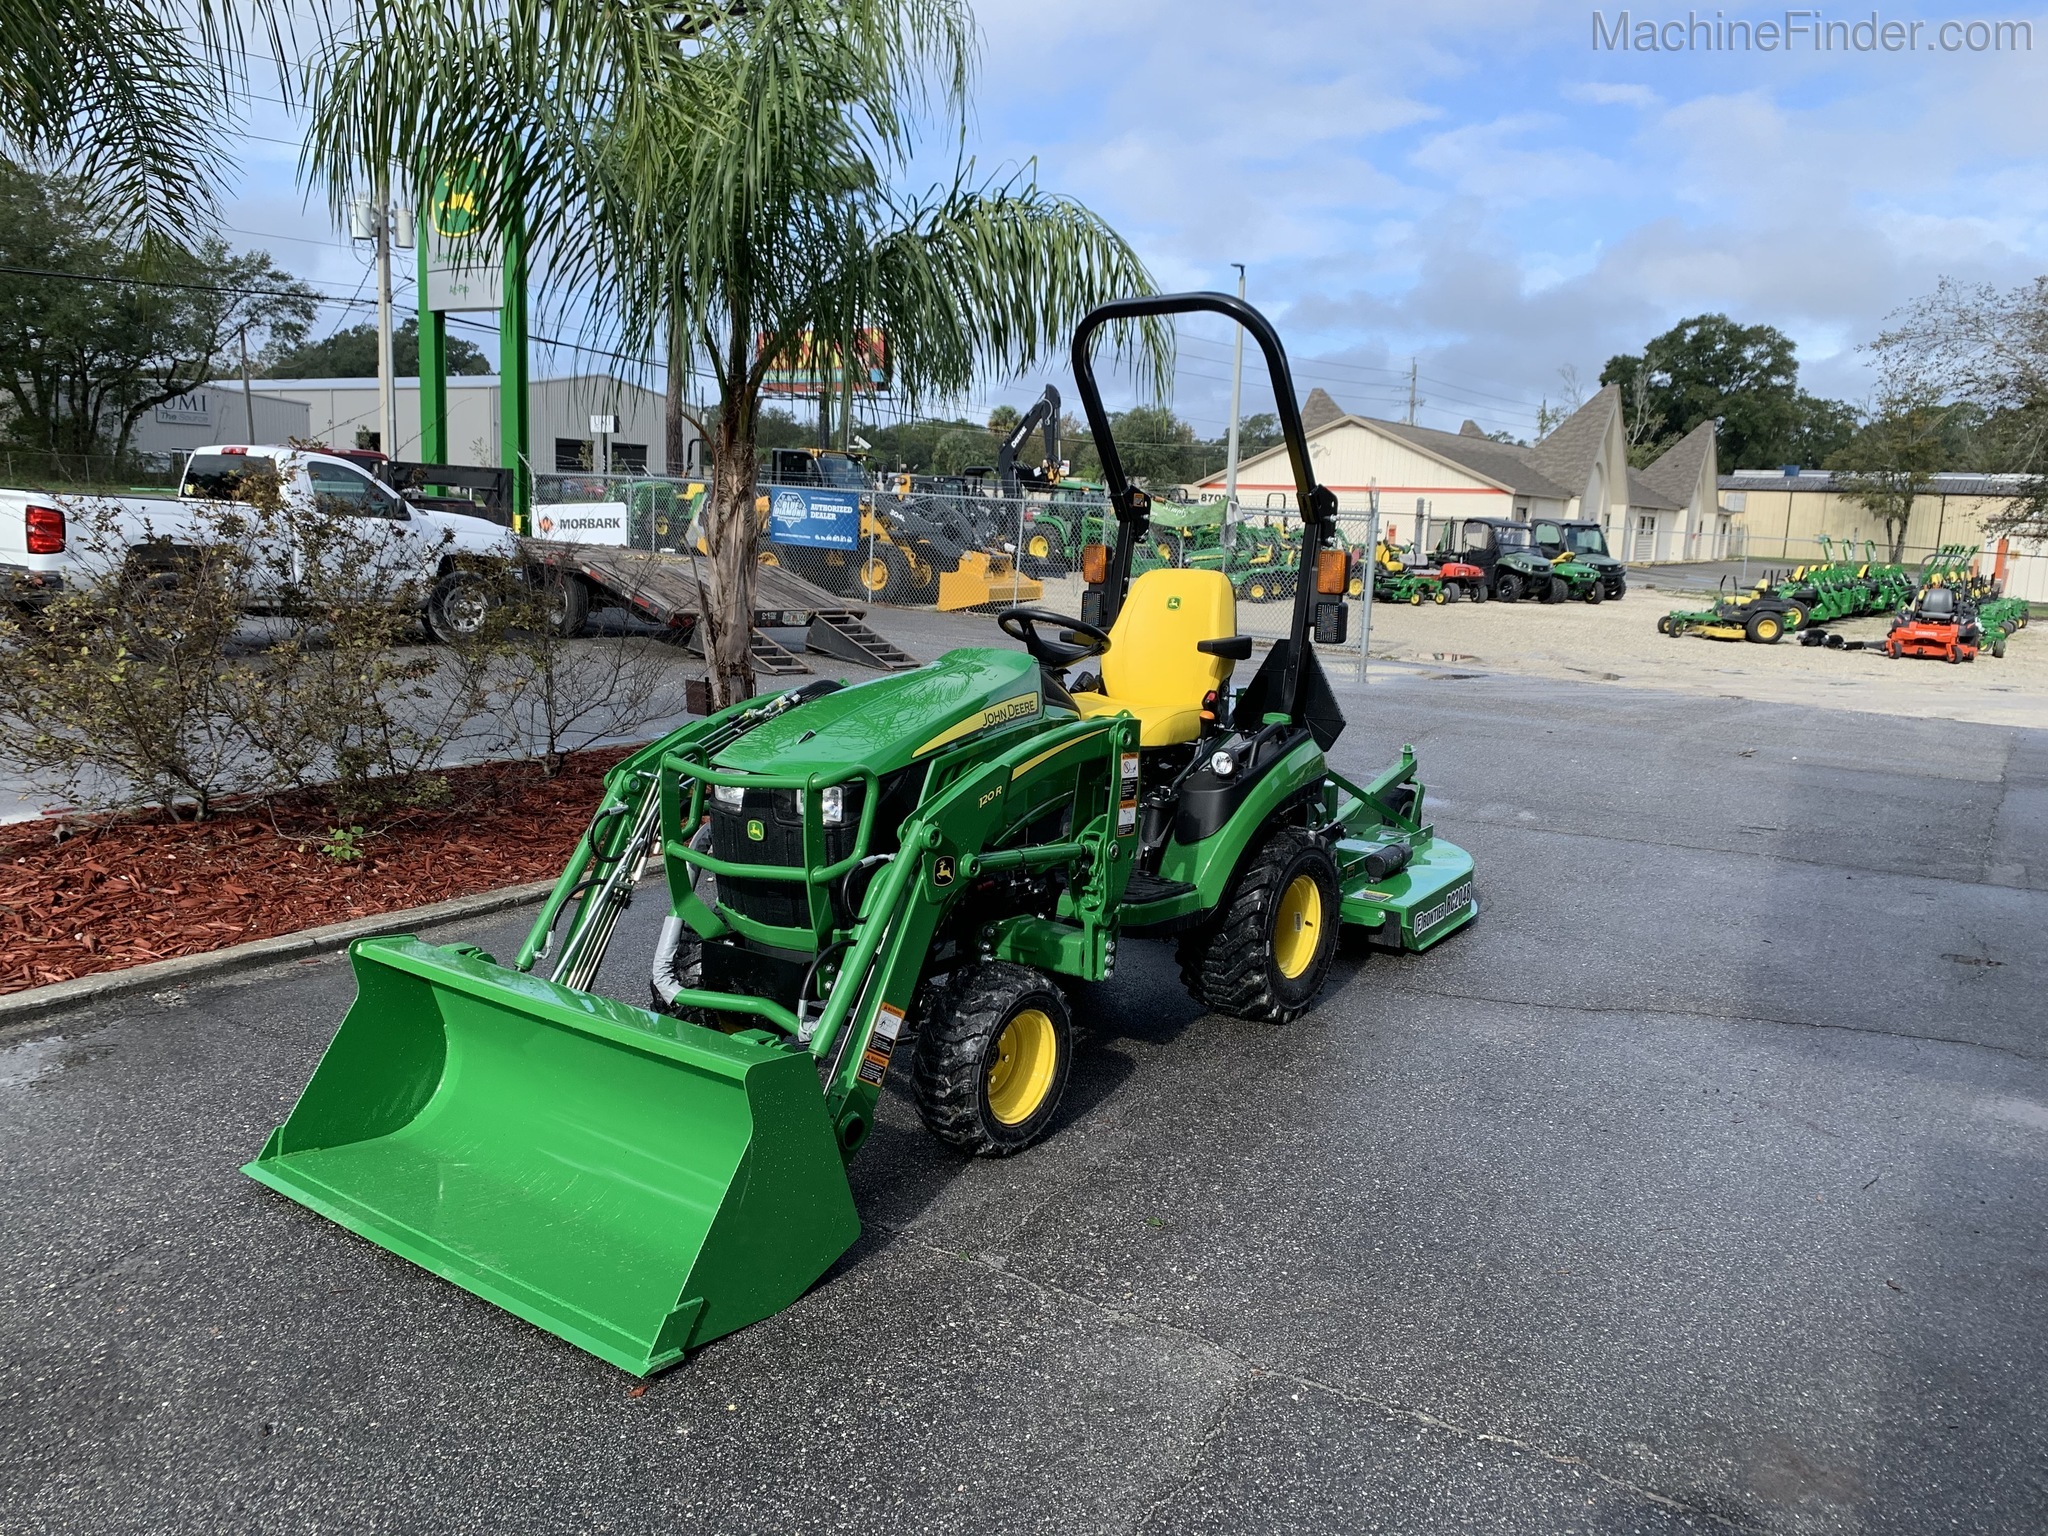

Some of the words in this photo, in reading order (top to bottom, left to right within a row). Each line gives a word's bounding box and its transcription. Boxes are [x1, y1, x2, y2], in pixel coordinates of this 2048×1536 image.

[162, 395, 206, 411] UMI
[161, 411, 177, 420] The
[782, 501, 801, 510] BLUE
[810, 503, 853, 514] AUTHORIZED
[774, 507, 806, 518] DIAMOND
[810, 511, 837, 521] DEALER
[559, 517, 621, 530] MORBARK
[982, 708, 1007, 727] JOHN
[1007, 700, 1036, 718] DEERE
[979, 790, 995, 809] 120
[995, 785, 1003, 797] R
[1446, 881, 1472, 916] RC2048
